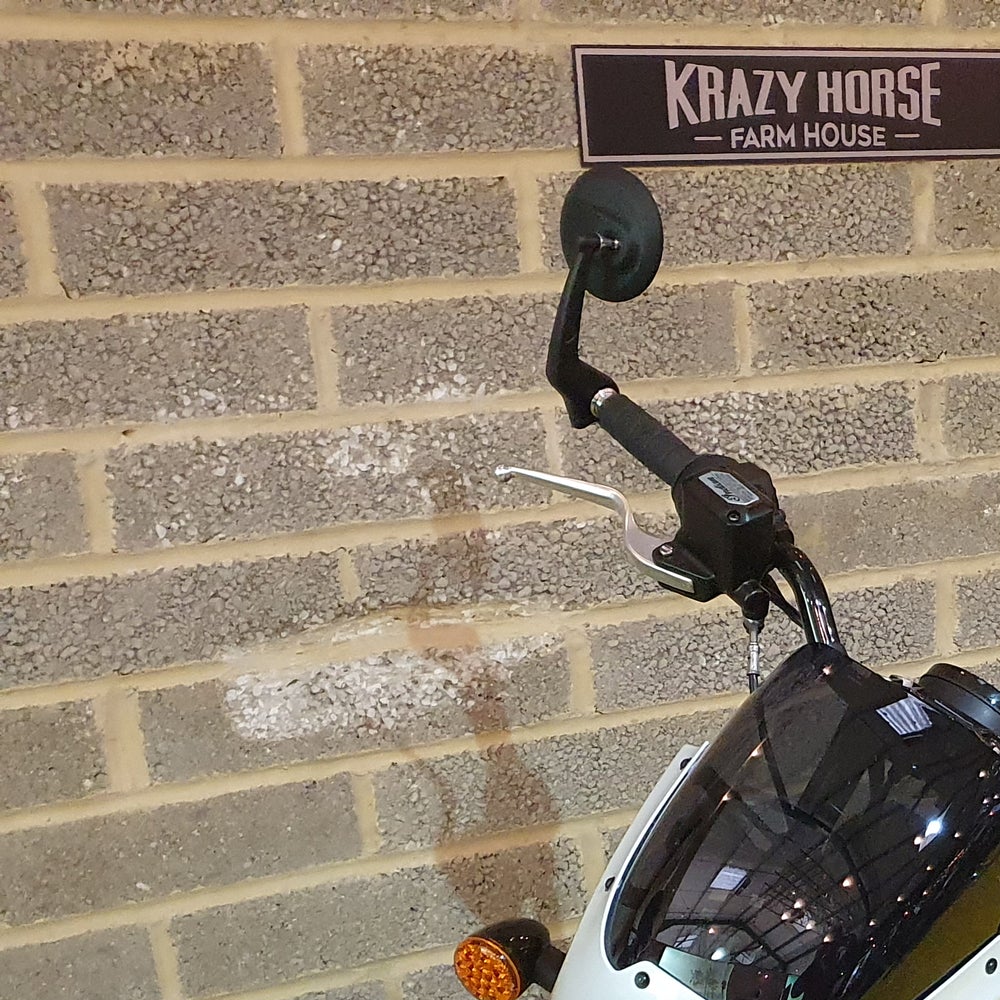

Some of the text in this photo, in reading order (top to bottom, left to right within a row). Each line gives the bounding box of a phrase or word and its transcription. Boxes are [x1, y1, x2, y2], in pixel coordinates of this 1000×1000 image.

[664, 60, 941, 129] KRAZY HORSE
[730, 122, 886, 148] FARM HOUSE
